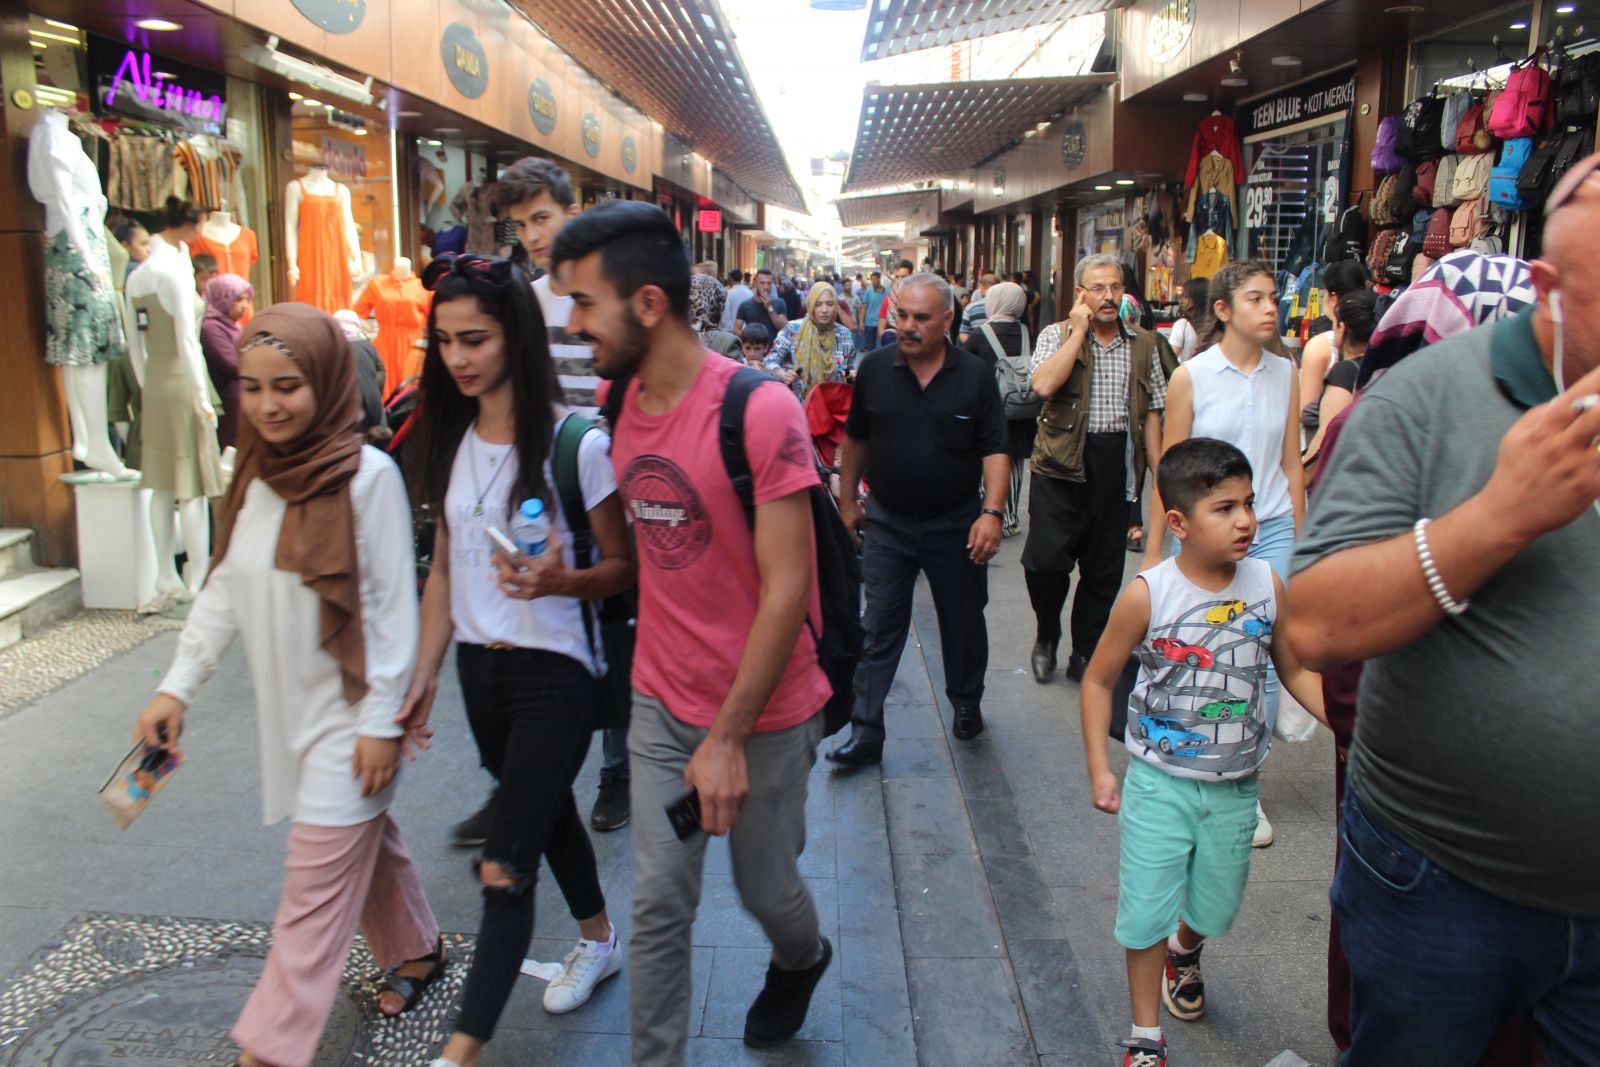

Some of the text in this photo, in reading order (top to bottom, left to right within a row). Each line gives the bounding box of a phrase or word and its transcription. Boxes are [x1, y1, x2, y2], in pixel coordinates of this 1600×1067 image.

[1253, 102, 1275, 128] TEEN
[1276, 97, 1301, 124] BLUE
[1307, 91, 1324, 114] KOT
